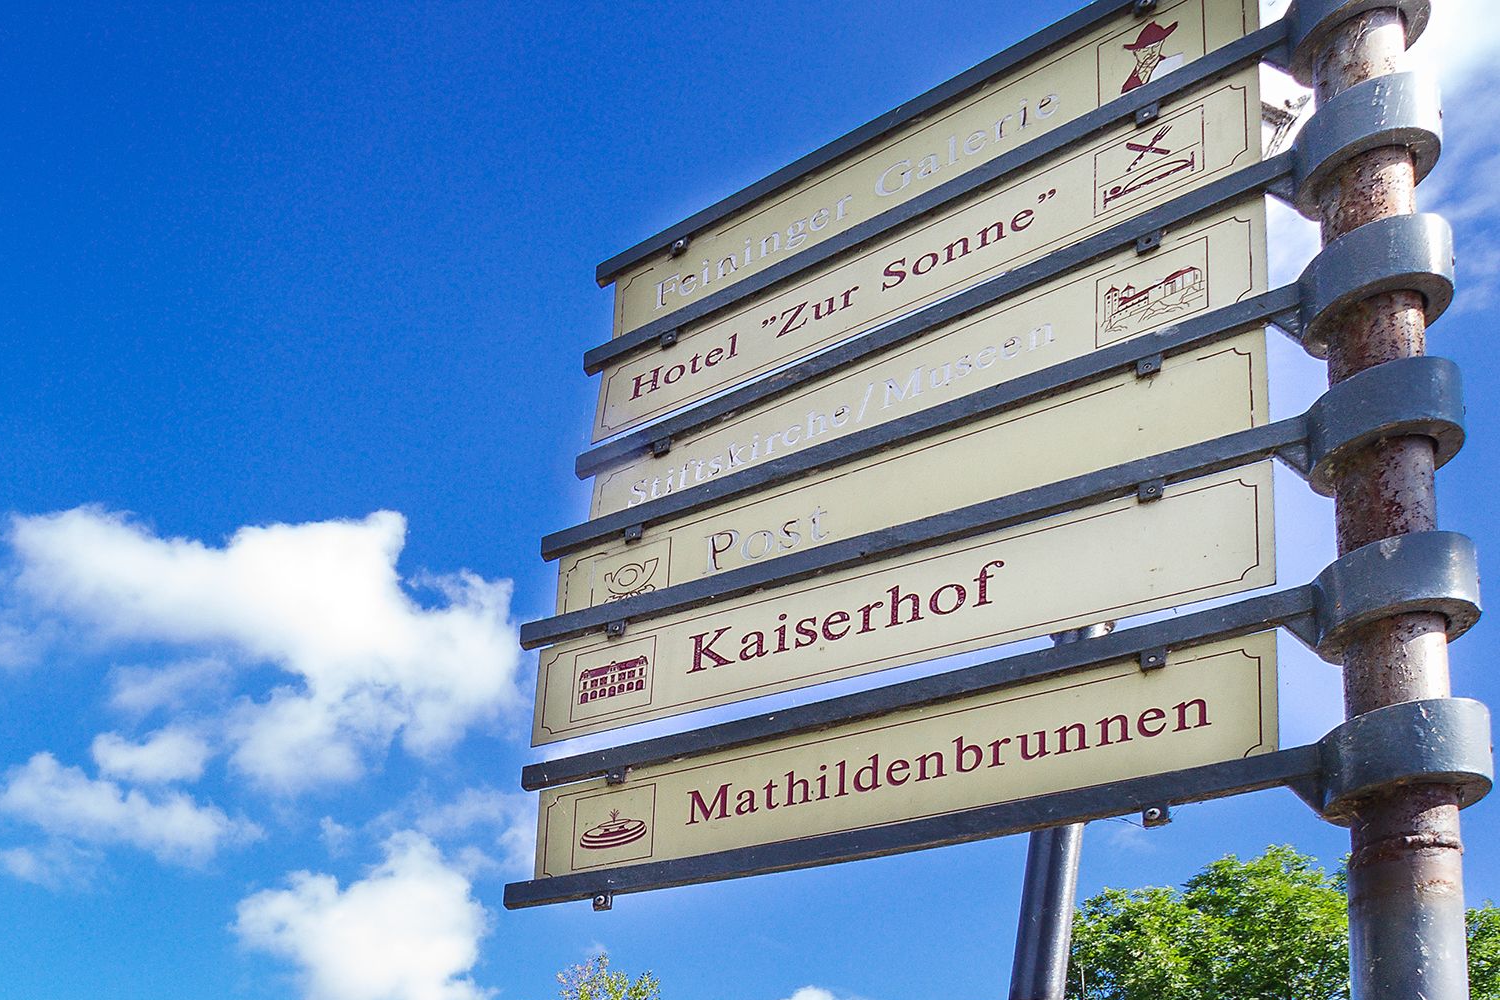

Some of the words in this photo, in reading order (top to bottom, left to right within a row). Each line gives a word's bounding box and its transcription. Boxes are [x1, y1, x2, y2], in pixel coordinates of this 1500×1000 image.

[652, 192, 854, 312] Feininger
[874, 92, 1060, 198] Galerie
[628, 334, 740, 402] Hotel
[701, 505, 831, 575] Post
[685, 559, 1005, 675] Kaiserhof
[685, 697, 1212, 826] Mathildenbrunnen
